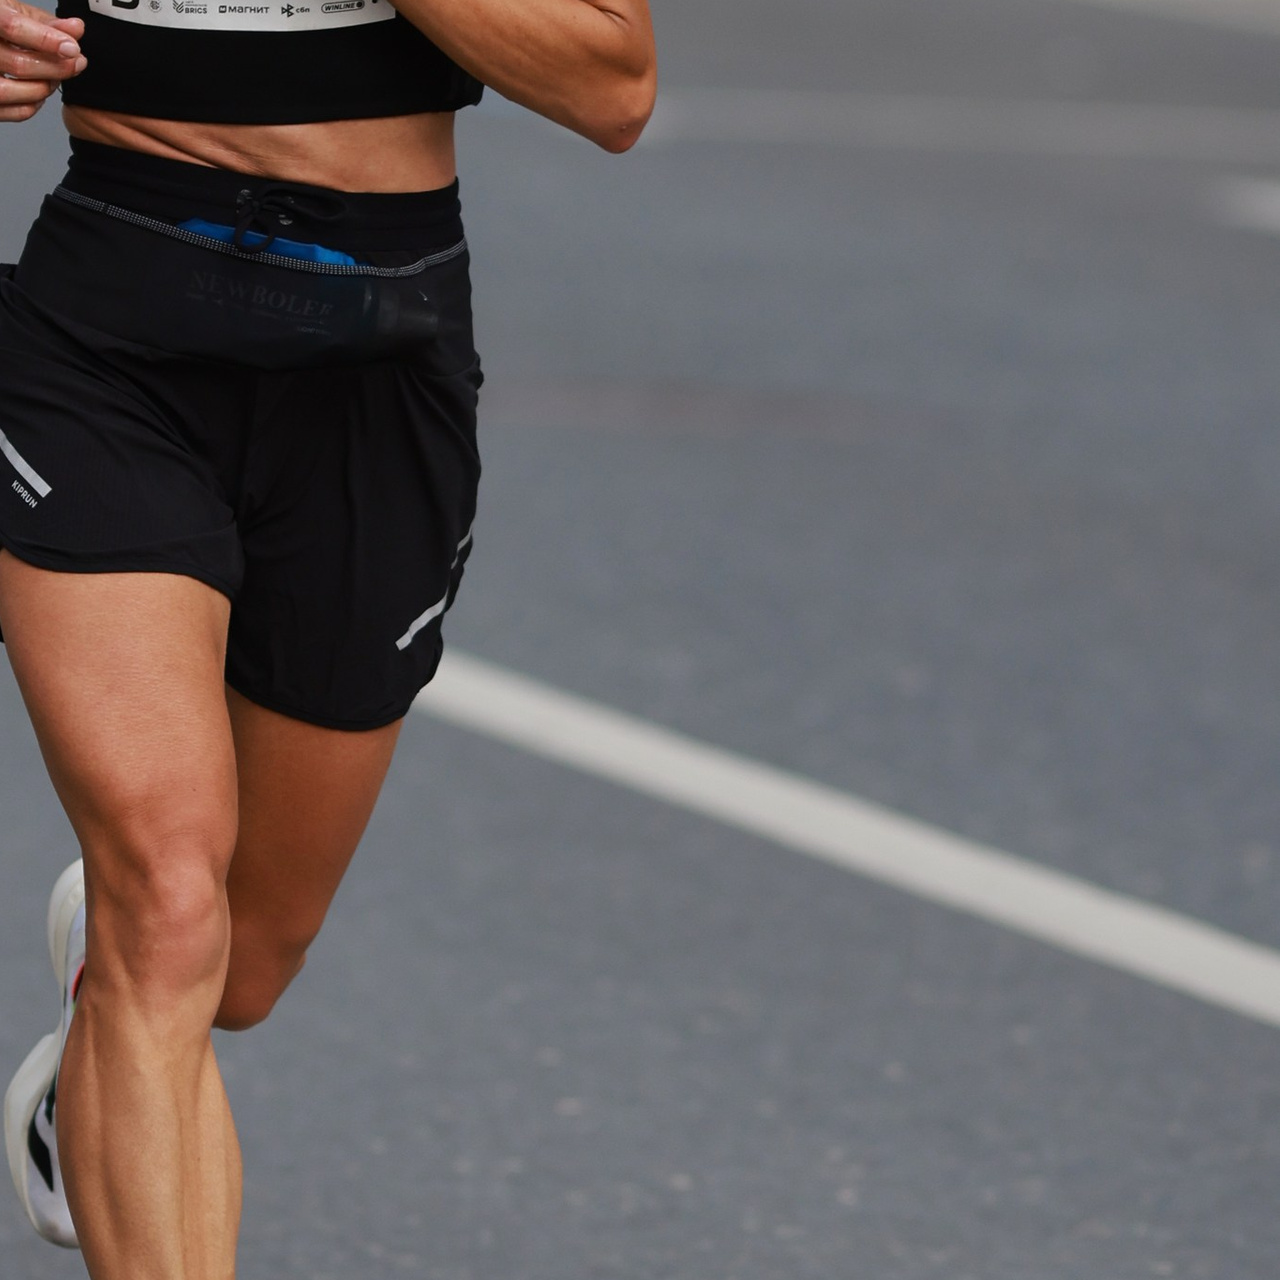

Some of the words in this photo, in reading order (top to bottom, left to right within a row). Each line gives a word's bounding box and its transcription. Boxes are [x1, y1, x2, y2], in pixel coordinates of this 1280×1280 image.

[228, 6, 270, 14] магнит
[324, 2, 356, 12] WINLINE
[11, 479, 38, 509] KIPRUN
